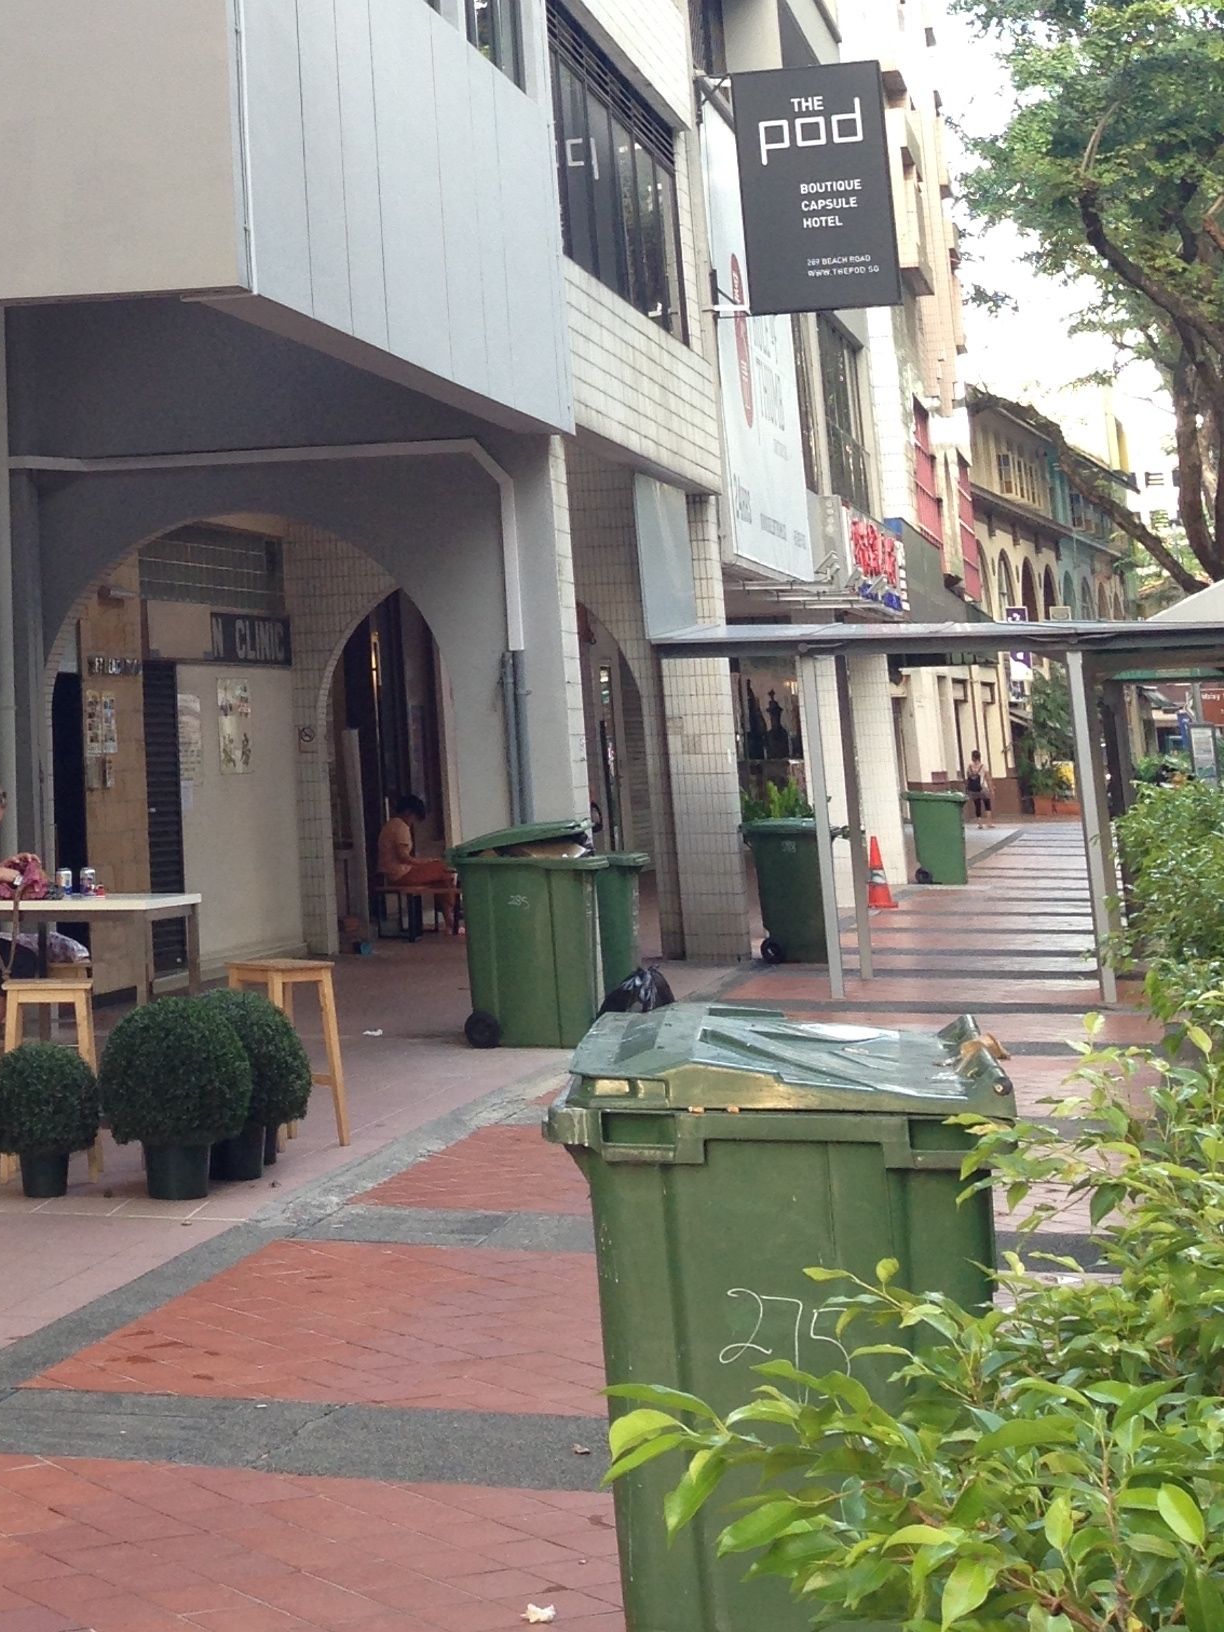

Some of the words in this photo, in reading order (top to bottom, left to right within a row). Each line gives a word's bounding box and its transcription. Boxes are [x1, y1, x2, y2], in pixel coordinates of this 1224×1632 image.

[791, 96, 824, 112] THE
[758, 97, 864, 166] pod
[800, 179, 862, 195] BOUTIQUE
[801, 197, 858, 212] CAPSULE
[803, 216, 843, 229] HOTEL
[822, 255, 848, 266] BEACH
[849, 254, 871, 264] ROAD
[234, 618, 286, 661] CLINIC
